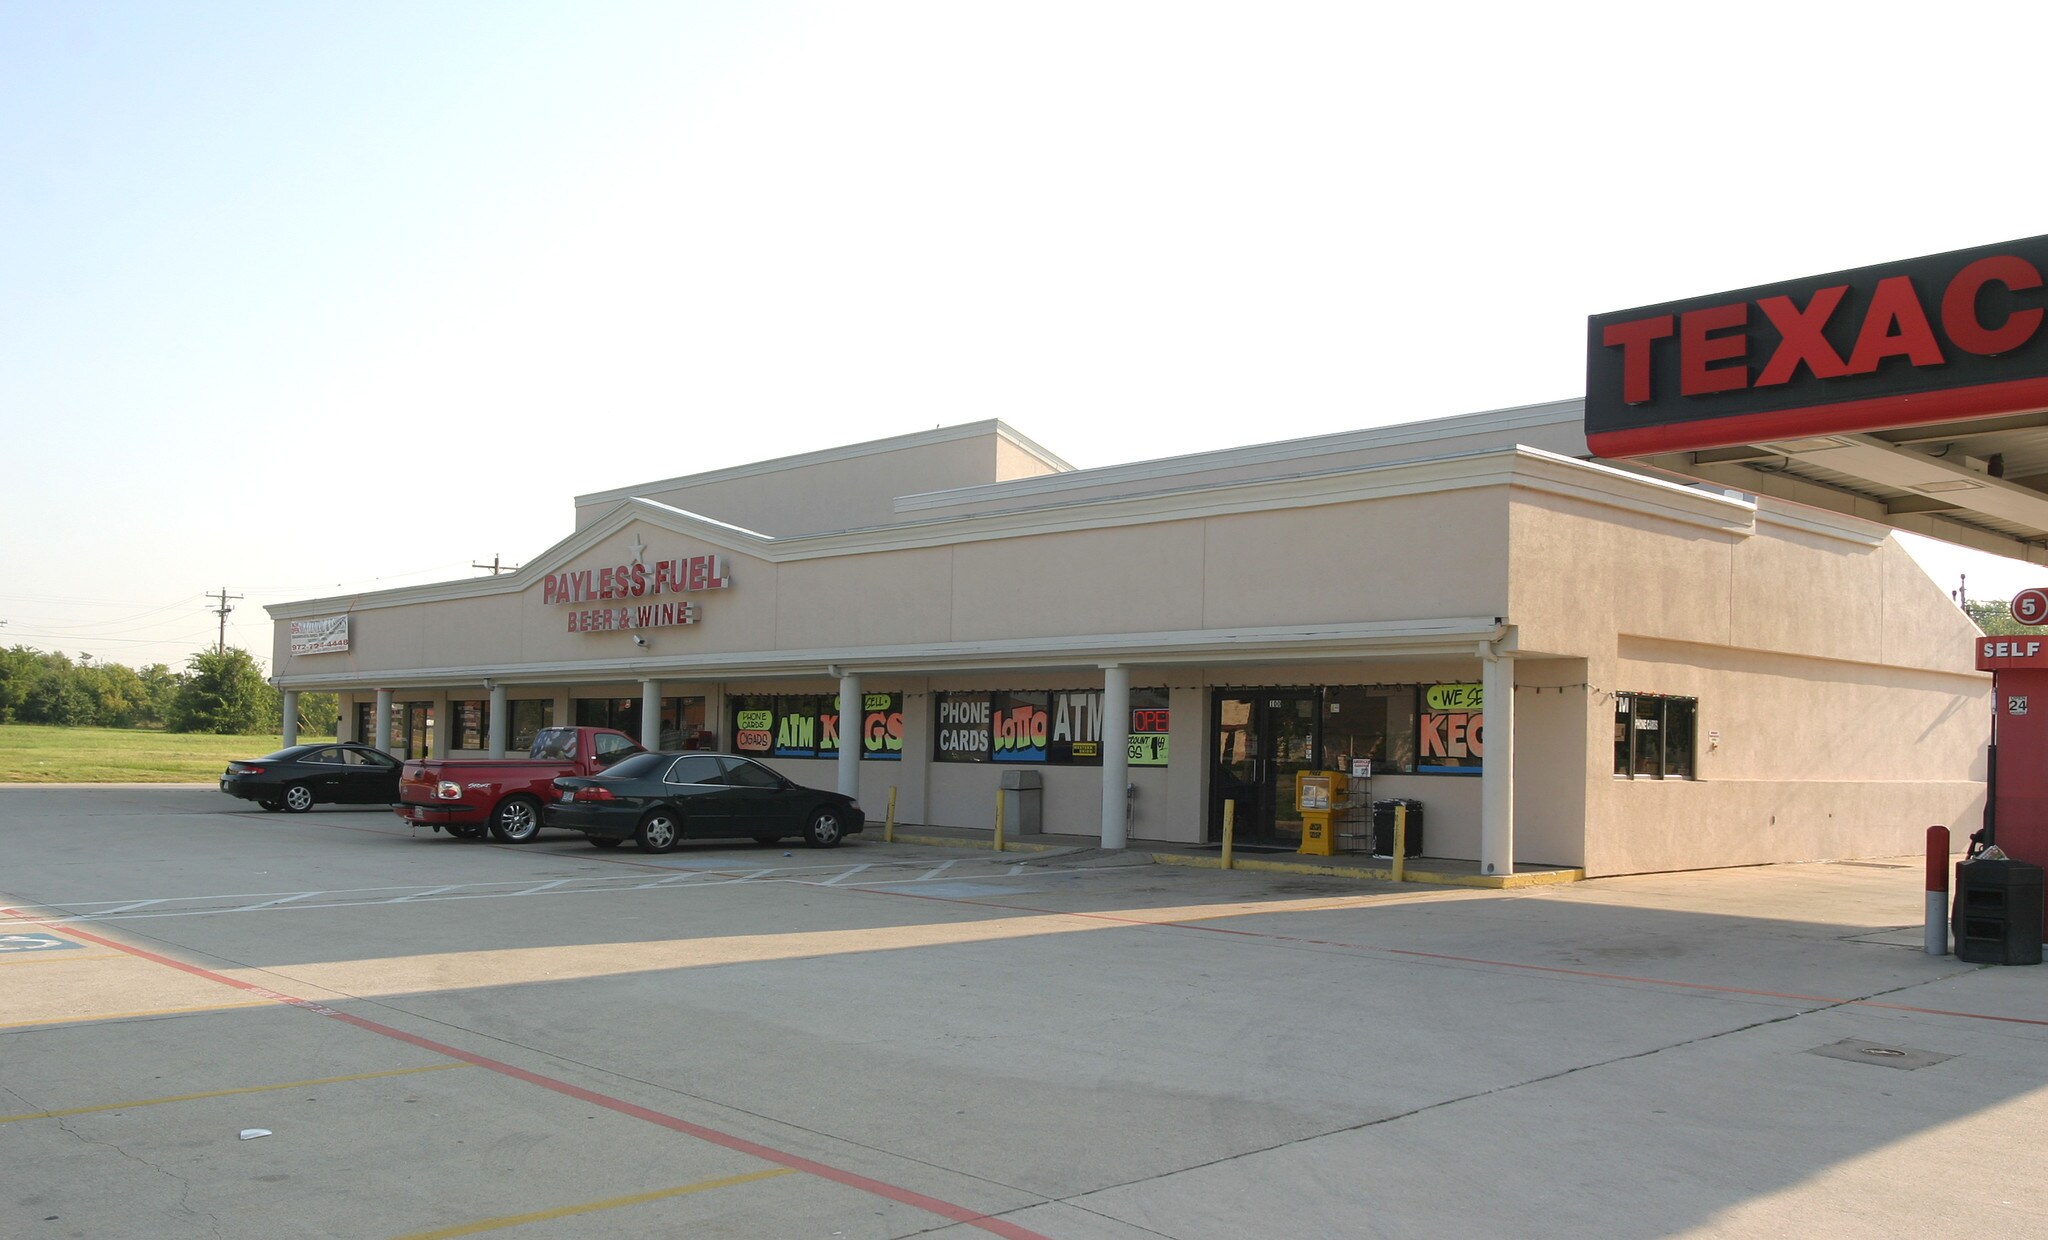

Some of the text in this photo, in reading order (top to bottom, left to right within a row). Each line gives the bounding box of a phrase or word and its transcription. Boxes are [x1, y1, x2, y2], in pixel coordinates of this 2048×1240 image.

[543, 555, 724, 604] PAYLESS FUEL
[568, 602, 689, 632] BEER & WINE
[2021, 598, 2036, 615] 5
[1984, 642, 2040, 658] SELF
[1441, 688, 1483, 707] WE SE
[2009, 700, 2027, 711] 24
[742, 711, 767, 721] PHONE
[940, 701, 990, 724] PHONE
[1053, 693, 1105, 742] ATM
[1135, 711, 1169, 731] OPE
[742, 721, 764, 729] CARDS
[777, 713, 814, 748] ATM
[993, 705, 1048, 751] LOTTO
[939, 729, 989, 751] CARDS
